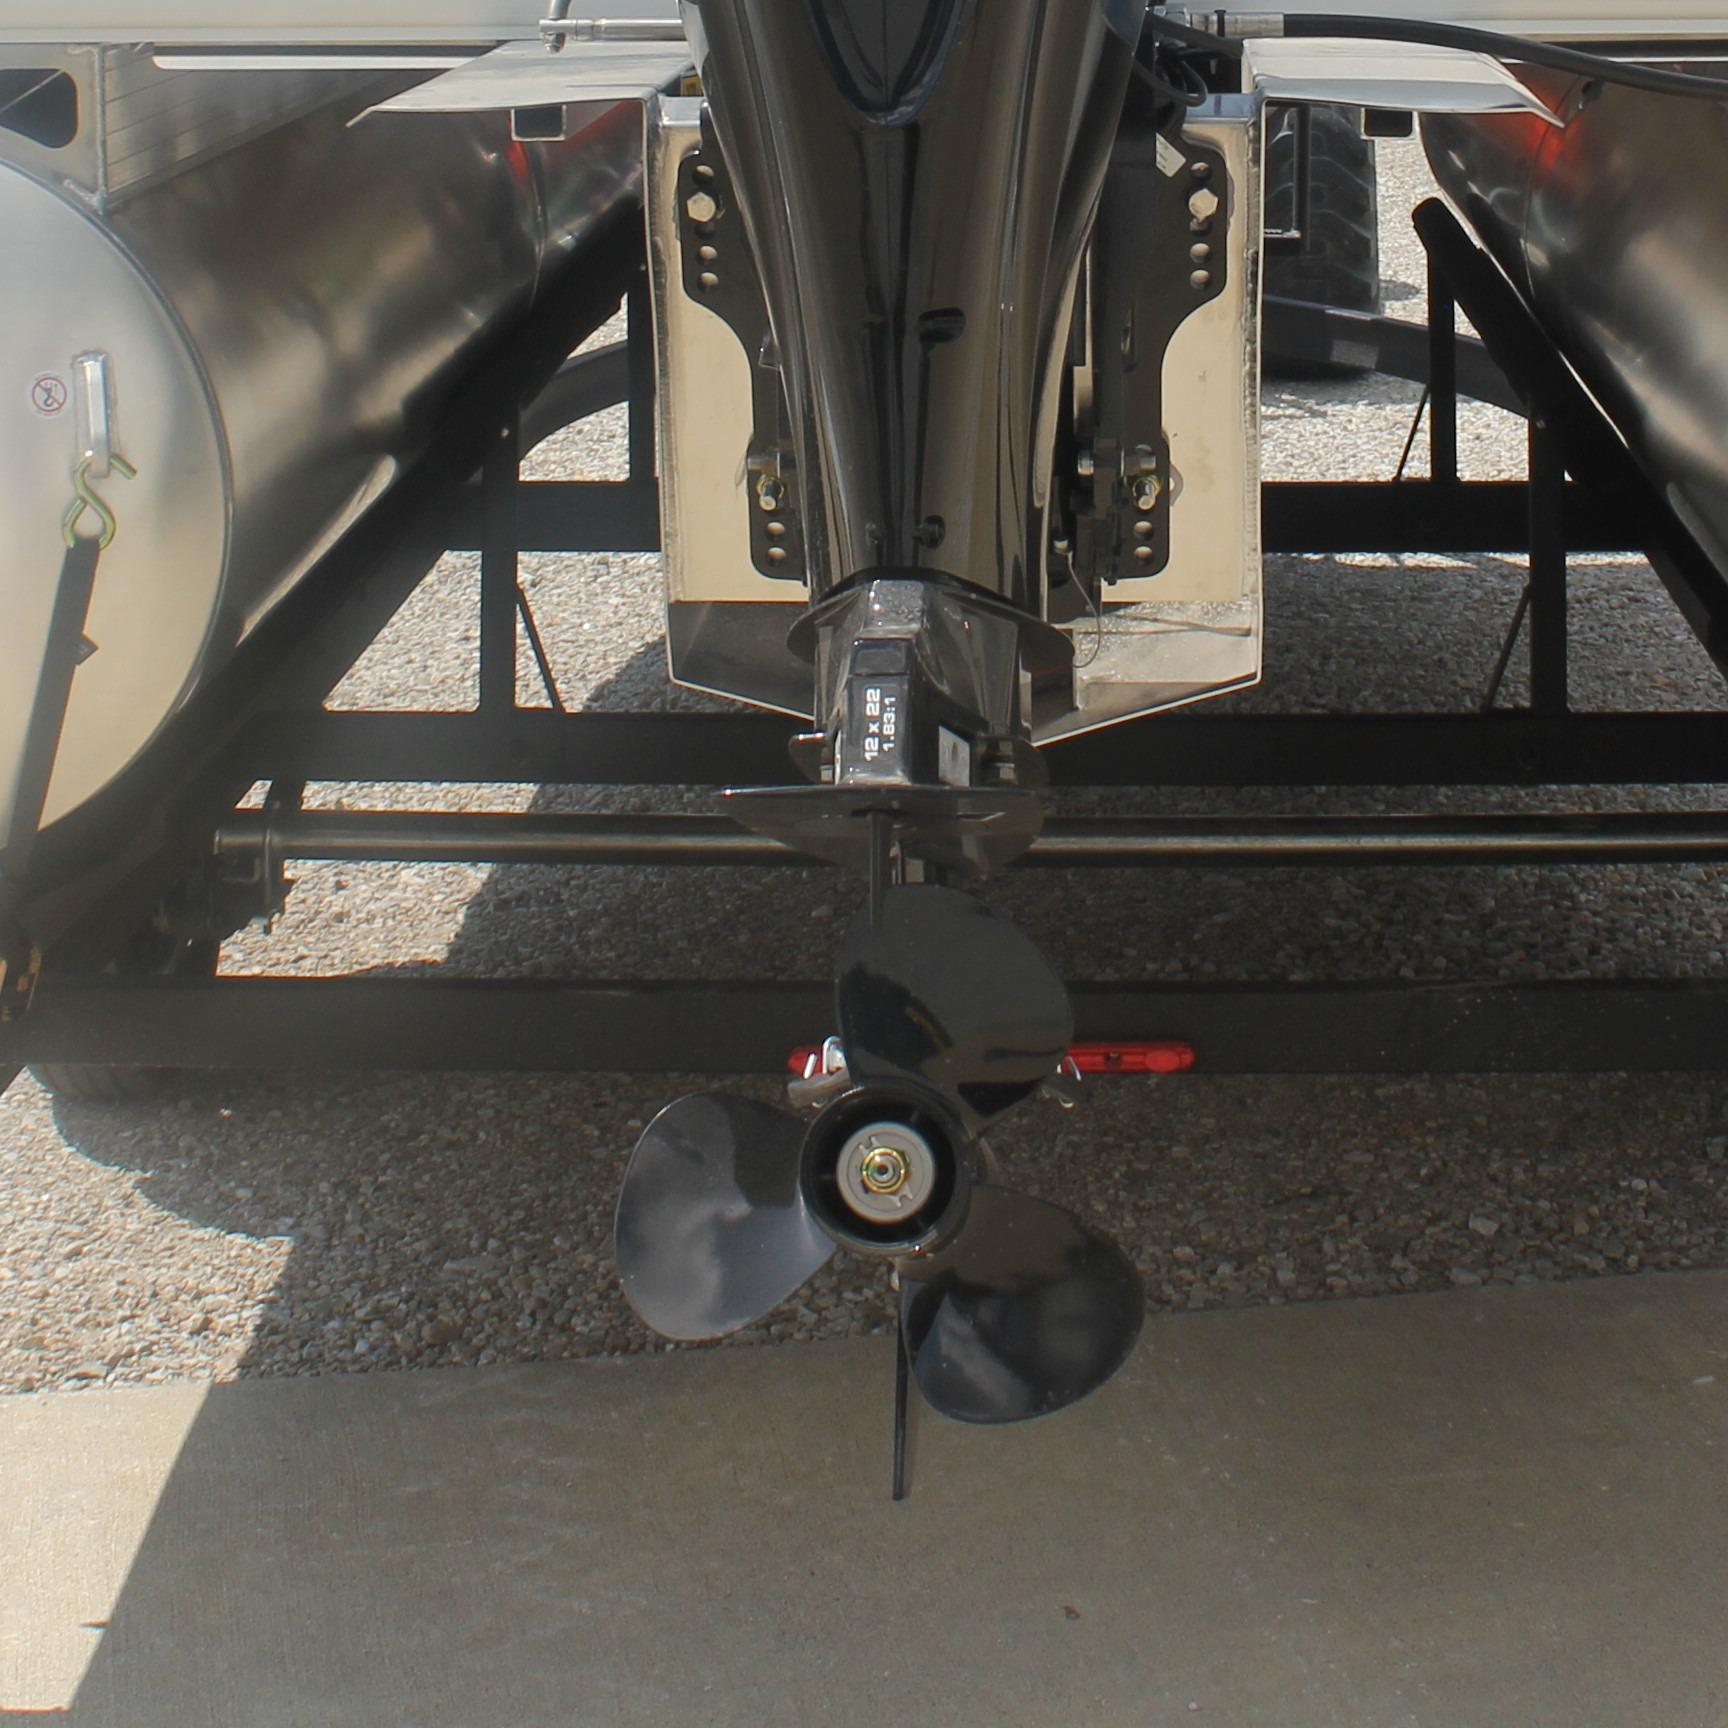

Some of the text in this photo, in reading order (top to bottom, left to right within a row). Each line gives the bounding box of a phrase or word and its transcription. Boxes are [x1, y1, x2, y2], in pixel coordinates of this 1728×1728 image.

[866, 688, 881, 717] 22
[882, 697, 896, 752] 1.83:1
[864, 737, 879, 762] 12
